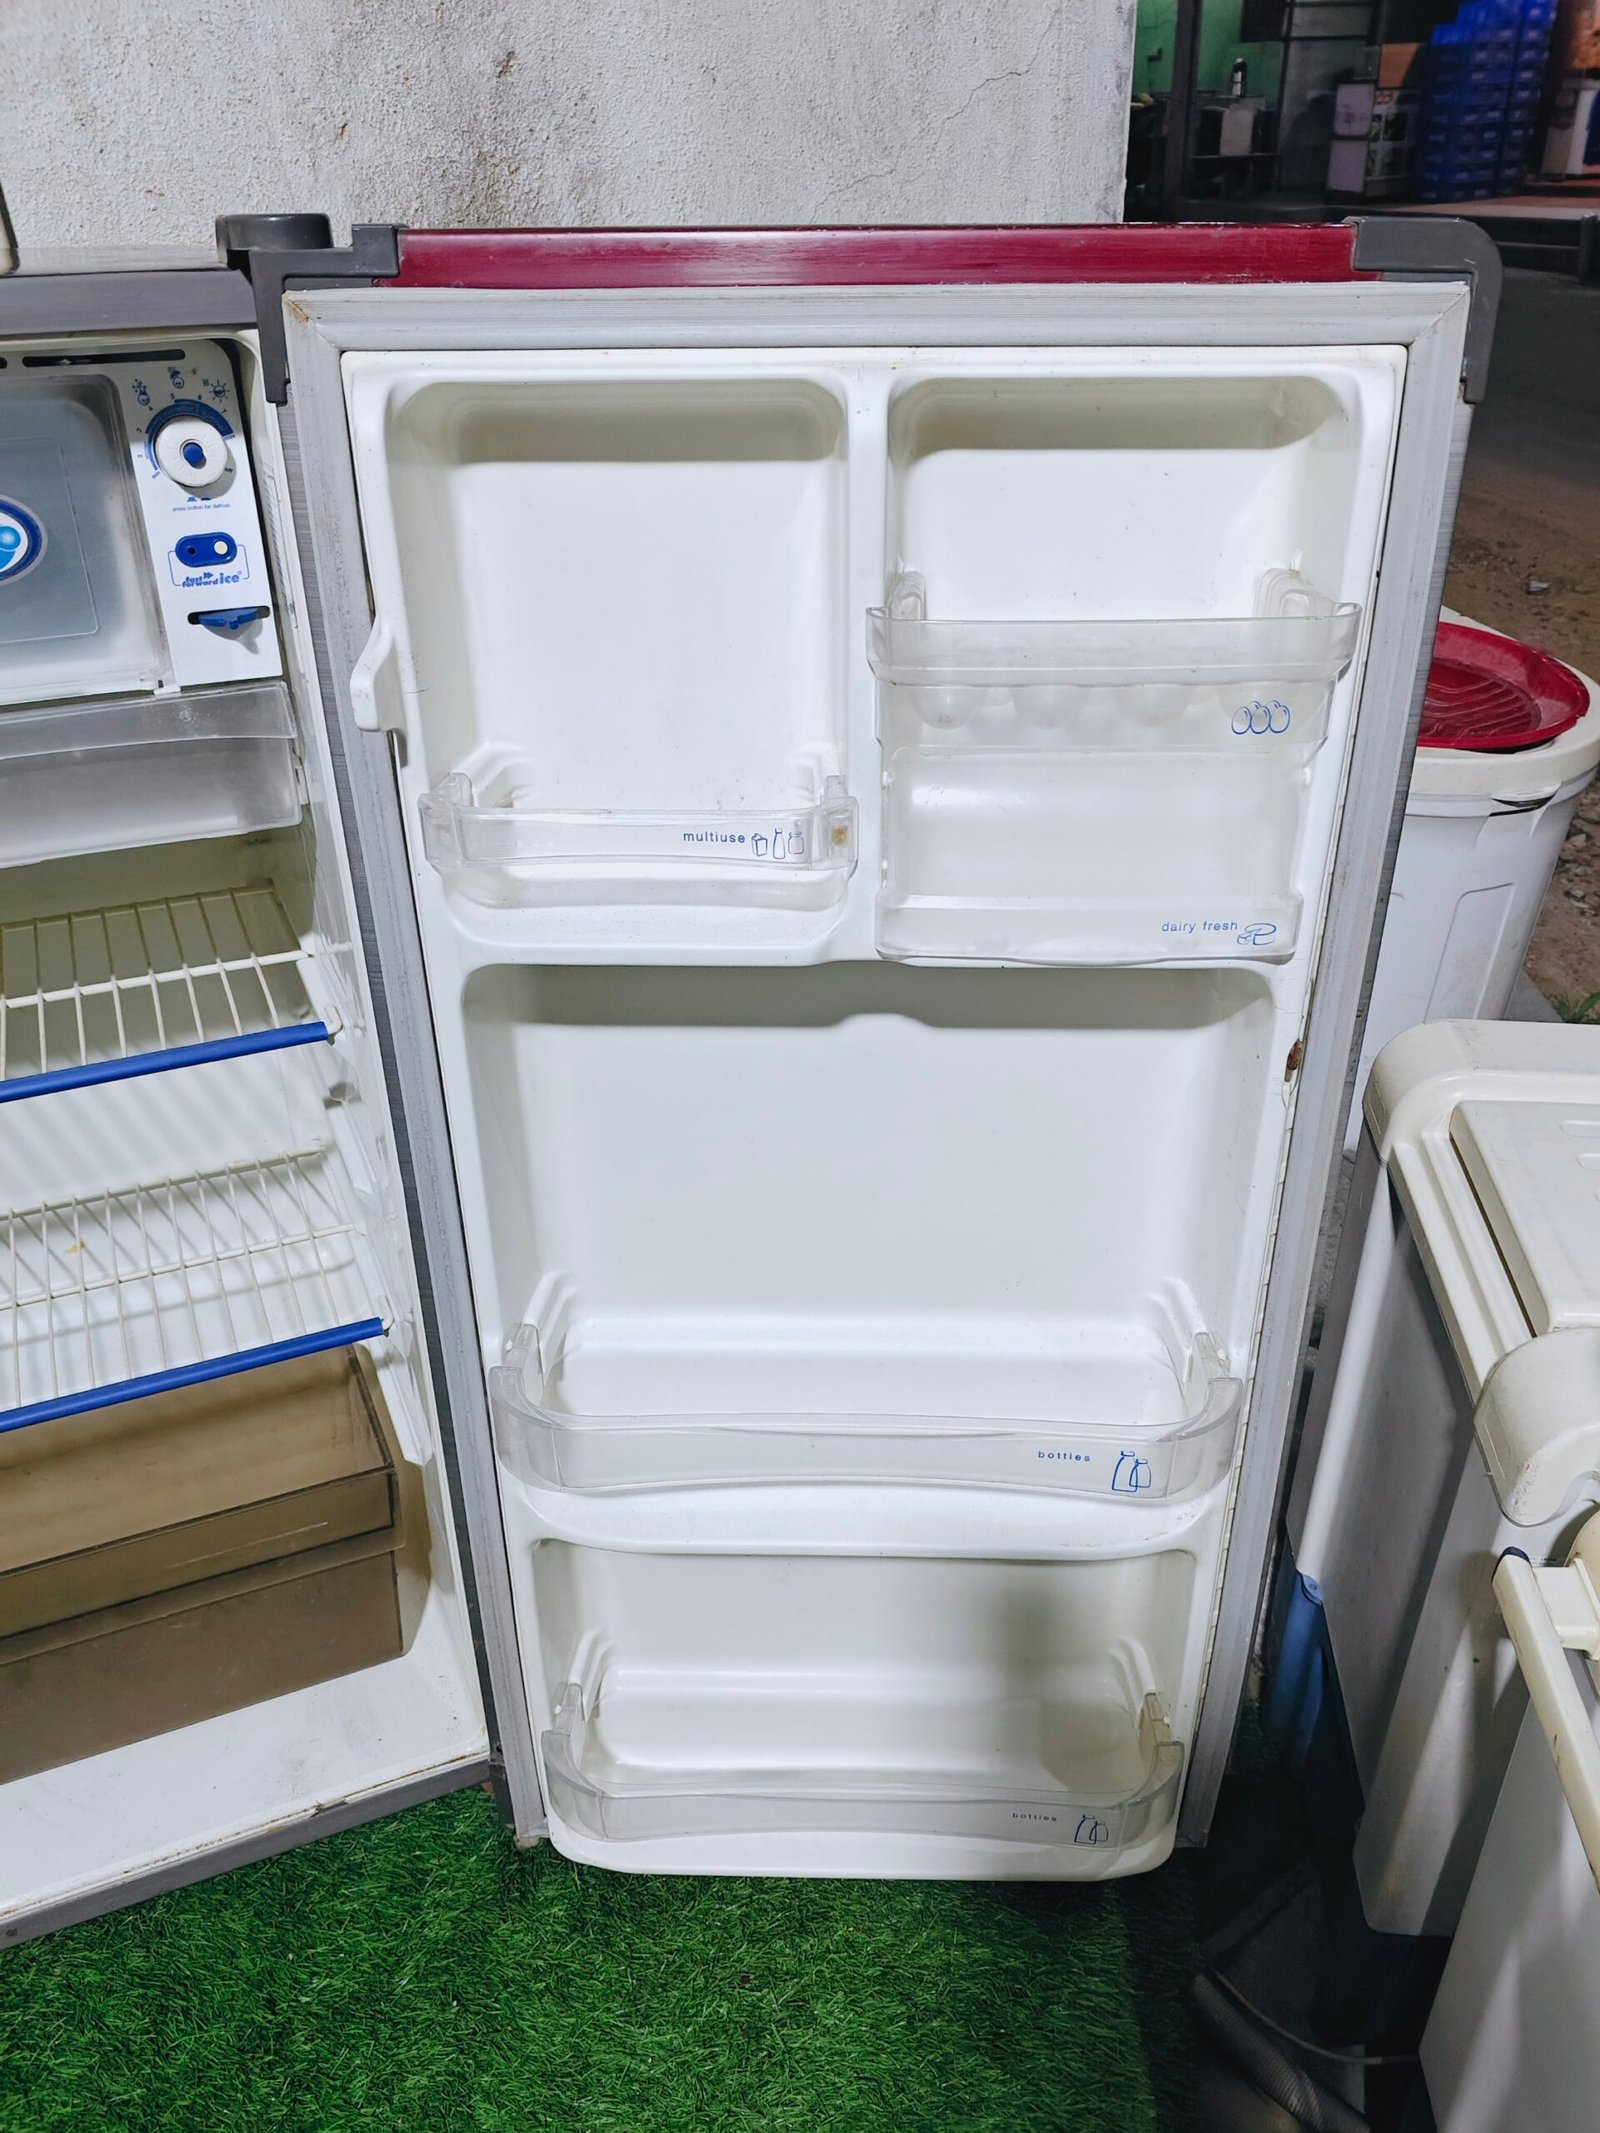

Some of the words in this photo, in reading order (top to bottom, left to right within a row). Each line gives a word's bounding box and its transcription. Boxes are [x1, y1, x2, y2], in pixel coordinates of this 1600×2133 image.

[182, 578, 218, 588] forward
[219, 572, 239, 584] ice
[683, 831, 745, 843] multiuse
[1161, 922, 1196, 933] dairy
[1203, 921, 1238, 931] fresh
[1038, 1450, 1090, 1462] bottles
[1012, 1812, 1057, 1822] bottles
